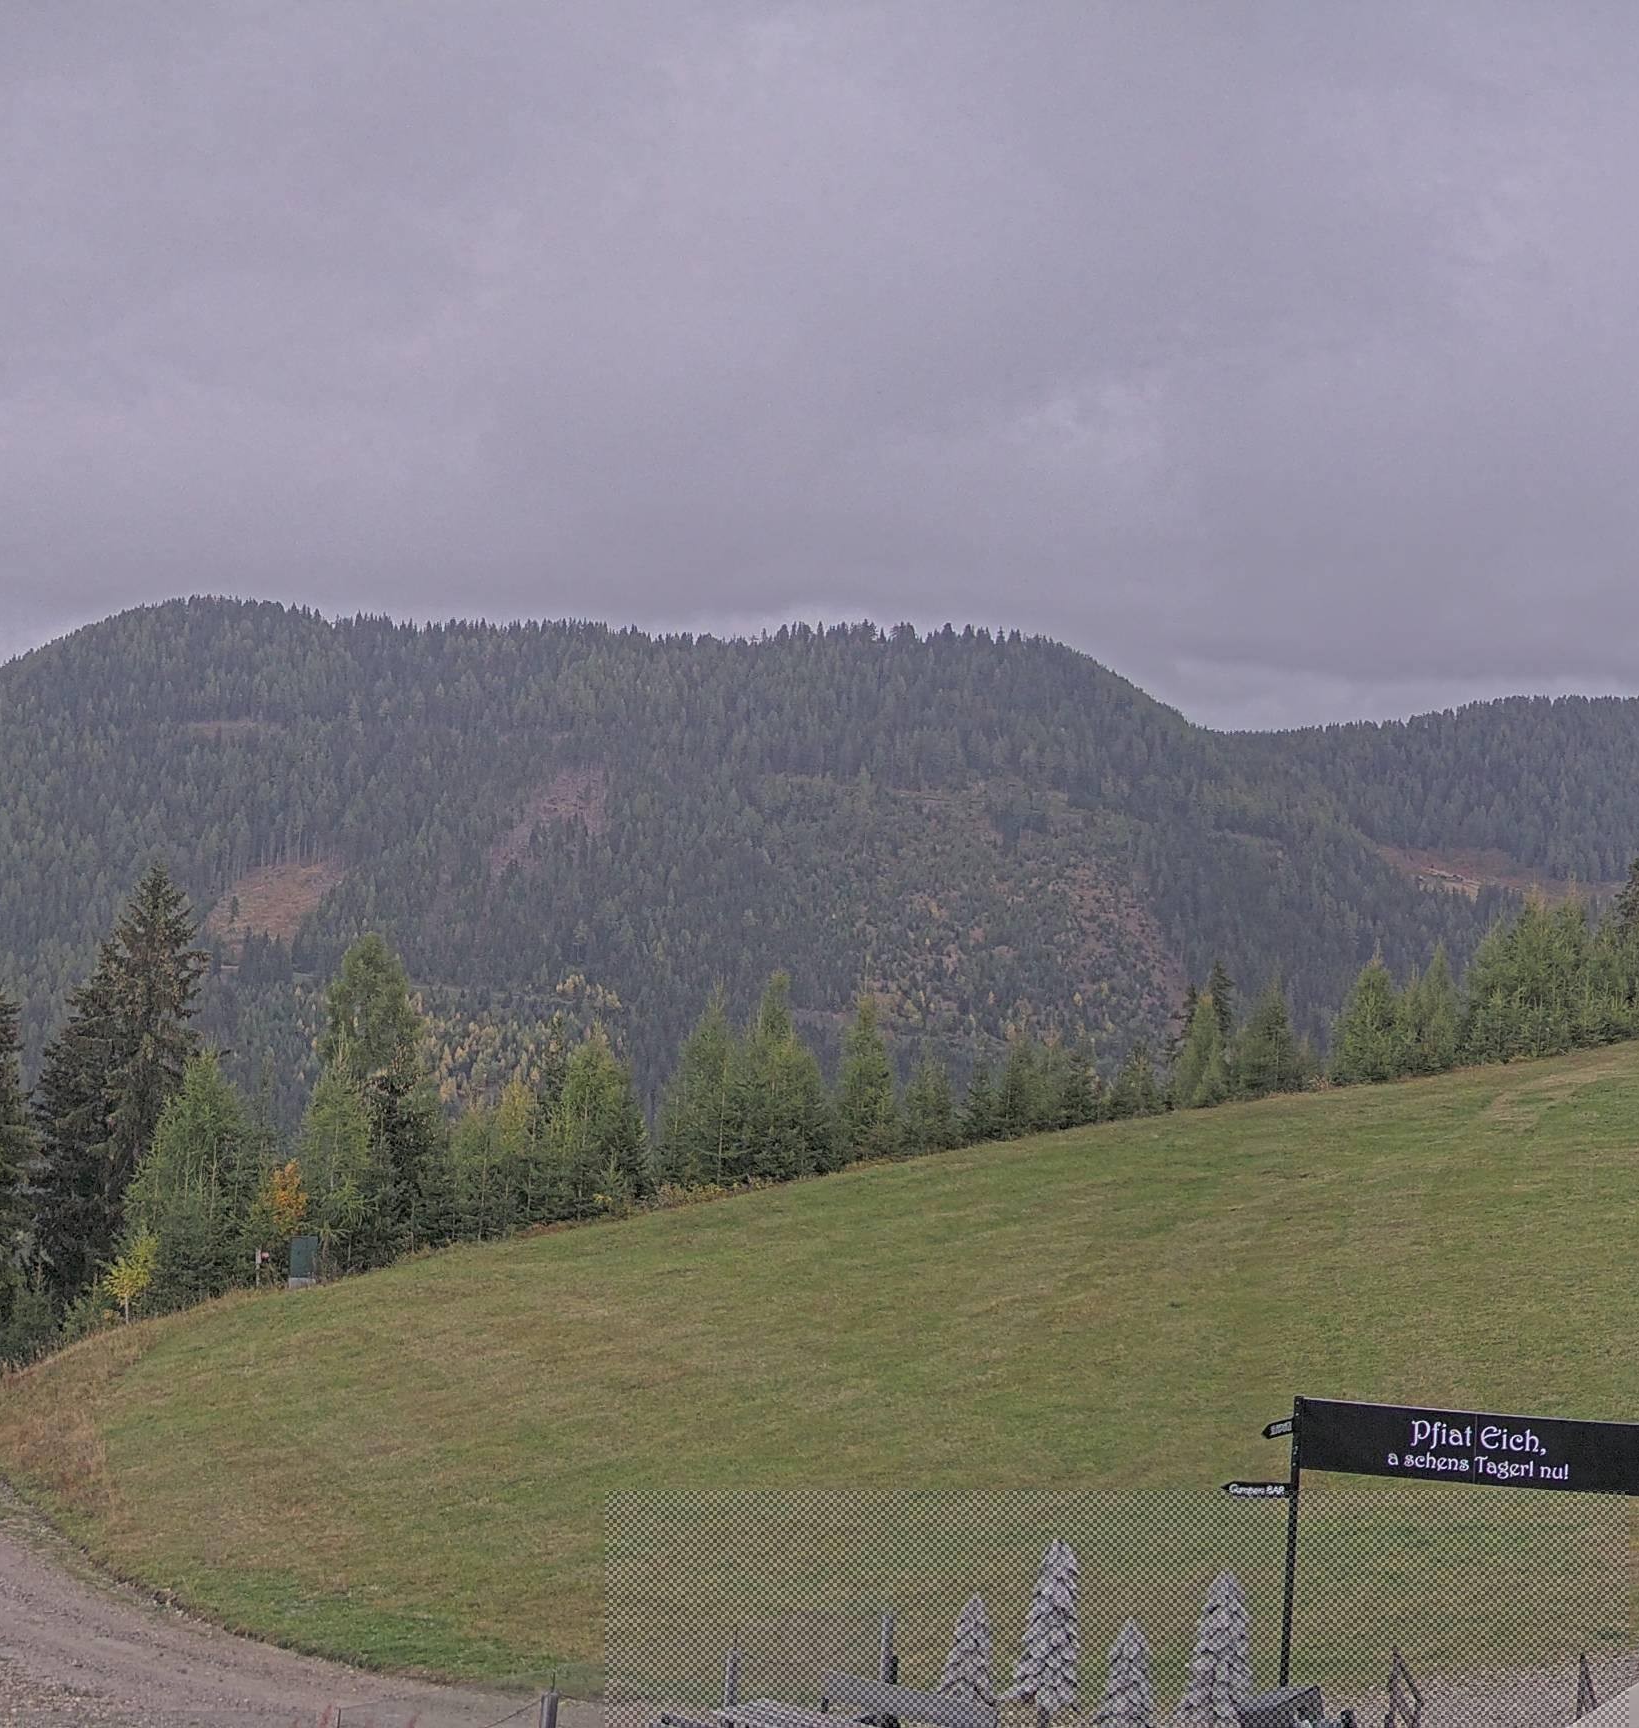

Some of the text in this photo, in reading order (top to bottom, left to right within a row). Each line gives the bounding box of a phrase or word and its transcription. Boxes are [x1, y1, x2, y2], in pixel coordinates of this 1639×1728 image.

[1410, 1420, 1547, 1456] Pfiat Eich,
[1387, 1452, 1569, 1480] a schens Tagerl nu!
